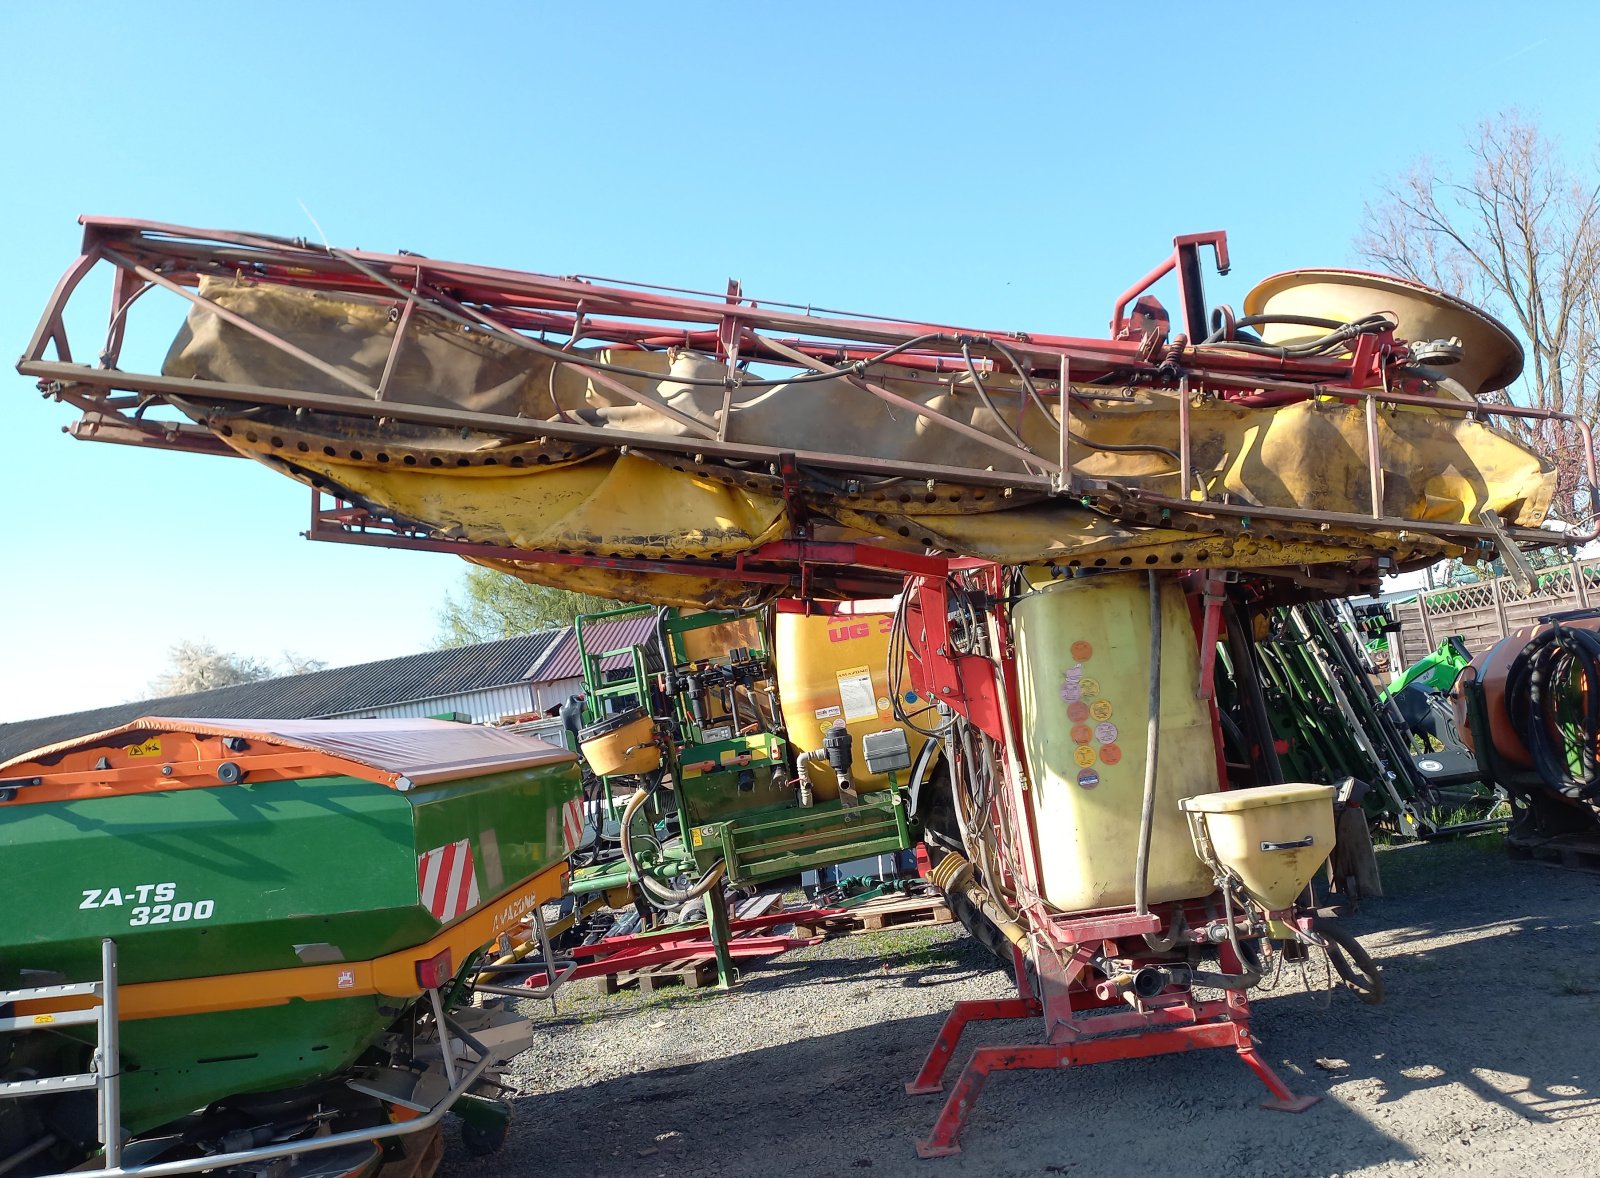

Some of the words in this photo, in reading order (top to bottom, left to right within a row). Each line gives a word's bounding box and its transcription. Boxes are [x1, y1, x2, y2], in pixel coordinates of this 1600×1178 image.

[829, 623, 869, 642] UG
[79, 882, 176, 909] ZA-TS
[129, 900, 215, 926] 3200
